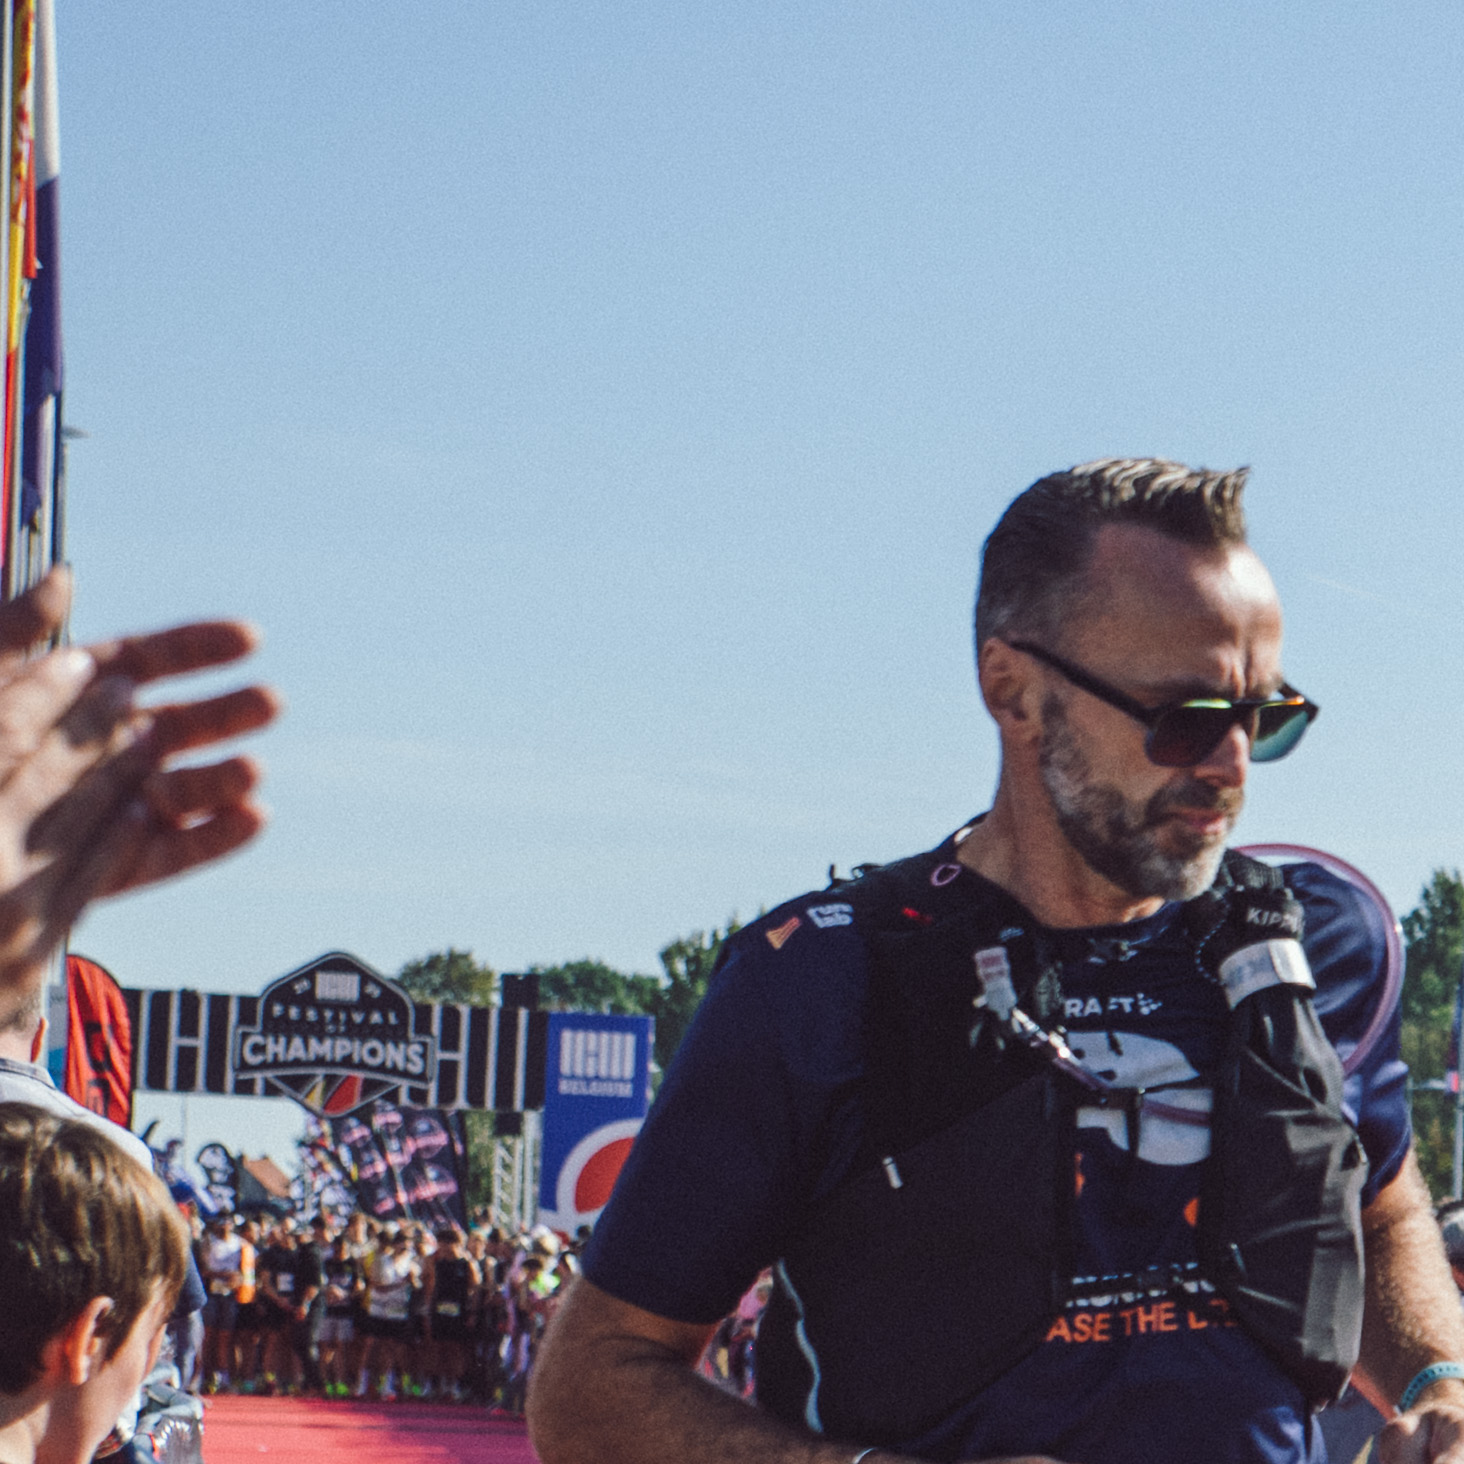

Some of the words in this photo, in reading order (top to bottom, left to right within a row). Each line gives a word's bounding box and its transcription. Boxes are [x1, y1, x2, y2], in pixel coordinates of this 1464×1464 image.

[272, 1002, 398, 1025] FESTIVAL
[1064, 997, 1134, 1018] RAFT
[242, 1034, 425, 1075] CHAMPIONS
[1046, 1315, 1112, 1343] ASE
[1120, 1302, 1179, 1335] THE
